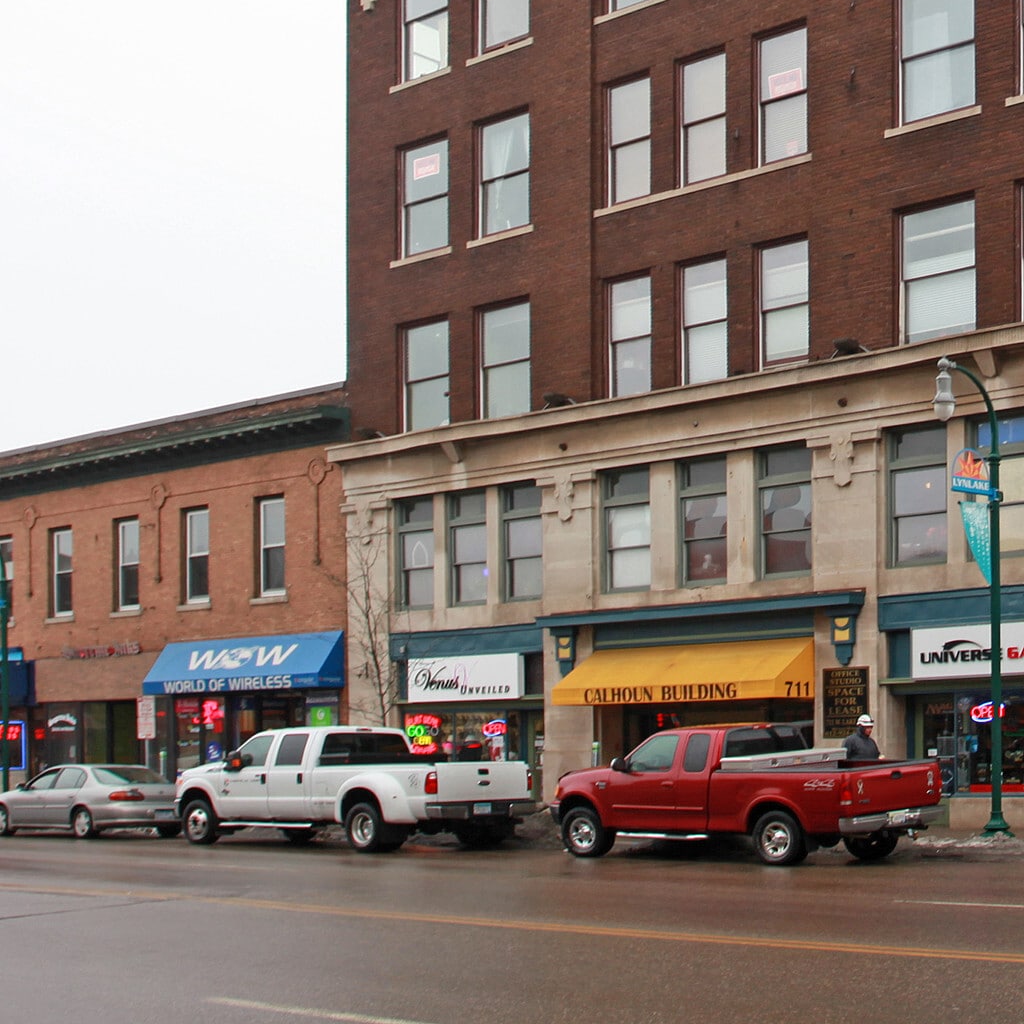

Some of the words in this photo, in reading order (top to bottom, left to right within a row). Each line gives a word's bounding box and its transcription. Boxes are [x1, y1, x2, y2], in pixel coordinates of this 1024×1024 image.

[952, 477, 990, 491] LYNLAKE
[188, 643, 299, 671] WOW
[920, 647, 1003, 665] UNIVERS
[414, 666, 460, 691] Venus
[830, 670, 860, 678] OFFICE
[163, 678, 206, 694] WORLD
[208, 677, 226, 692] OF
[228, 675, 292, 691] WIRELESS
[830, 678, 862, 686] STUDIO
[584, 686, 653, 704] CALHOUN
[661, 683, 737, 701] BUILDING
[785, 681, 810, 697] 711
[827, 687, 864, 696] SPACE
[834, 697, 857, 706] FOR
[828, 706, 864, 715] LEASE
[406, 725, 426, 737] GO
[483, 723, 508, 735] OPEN
